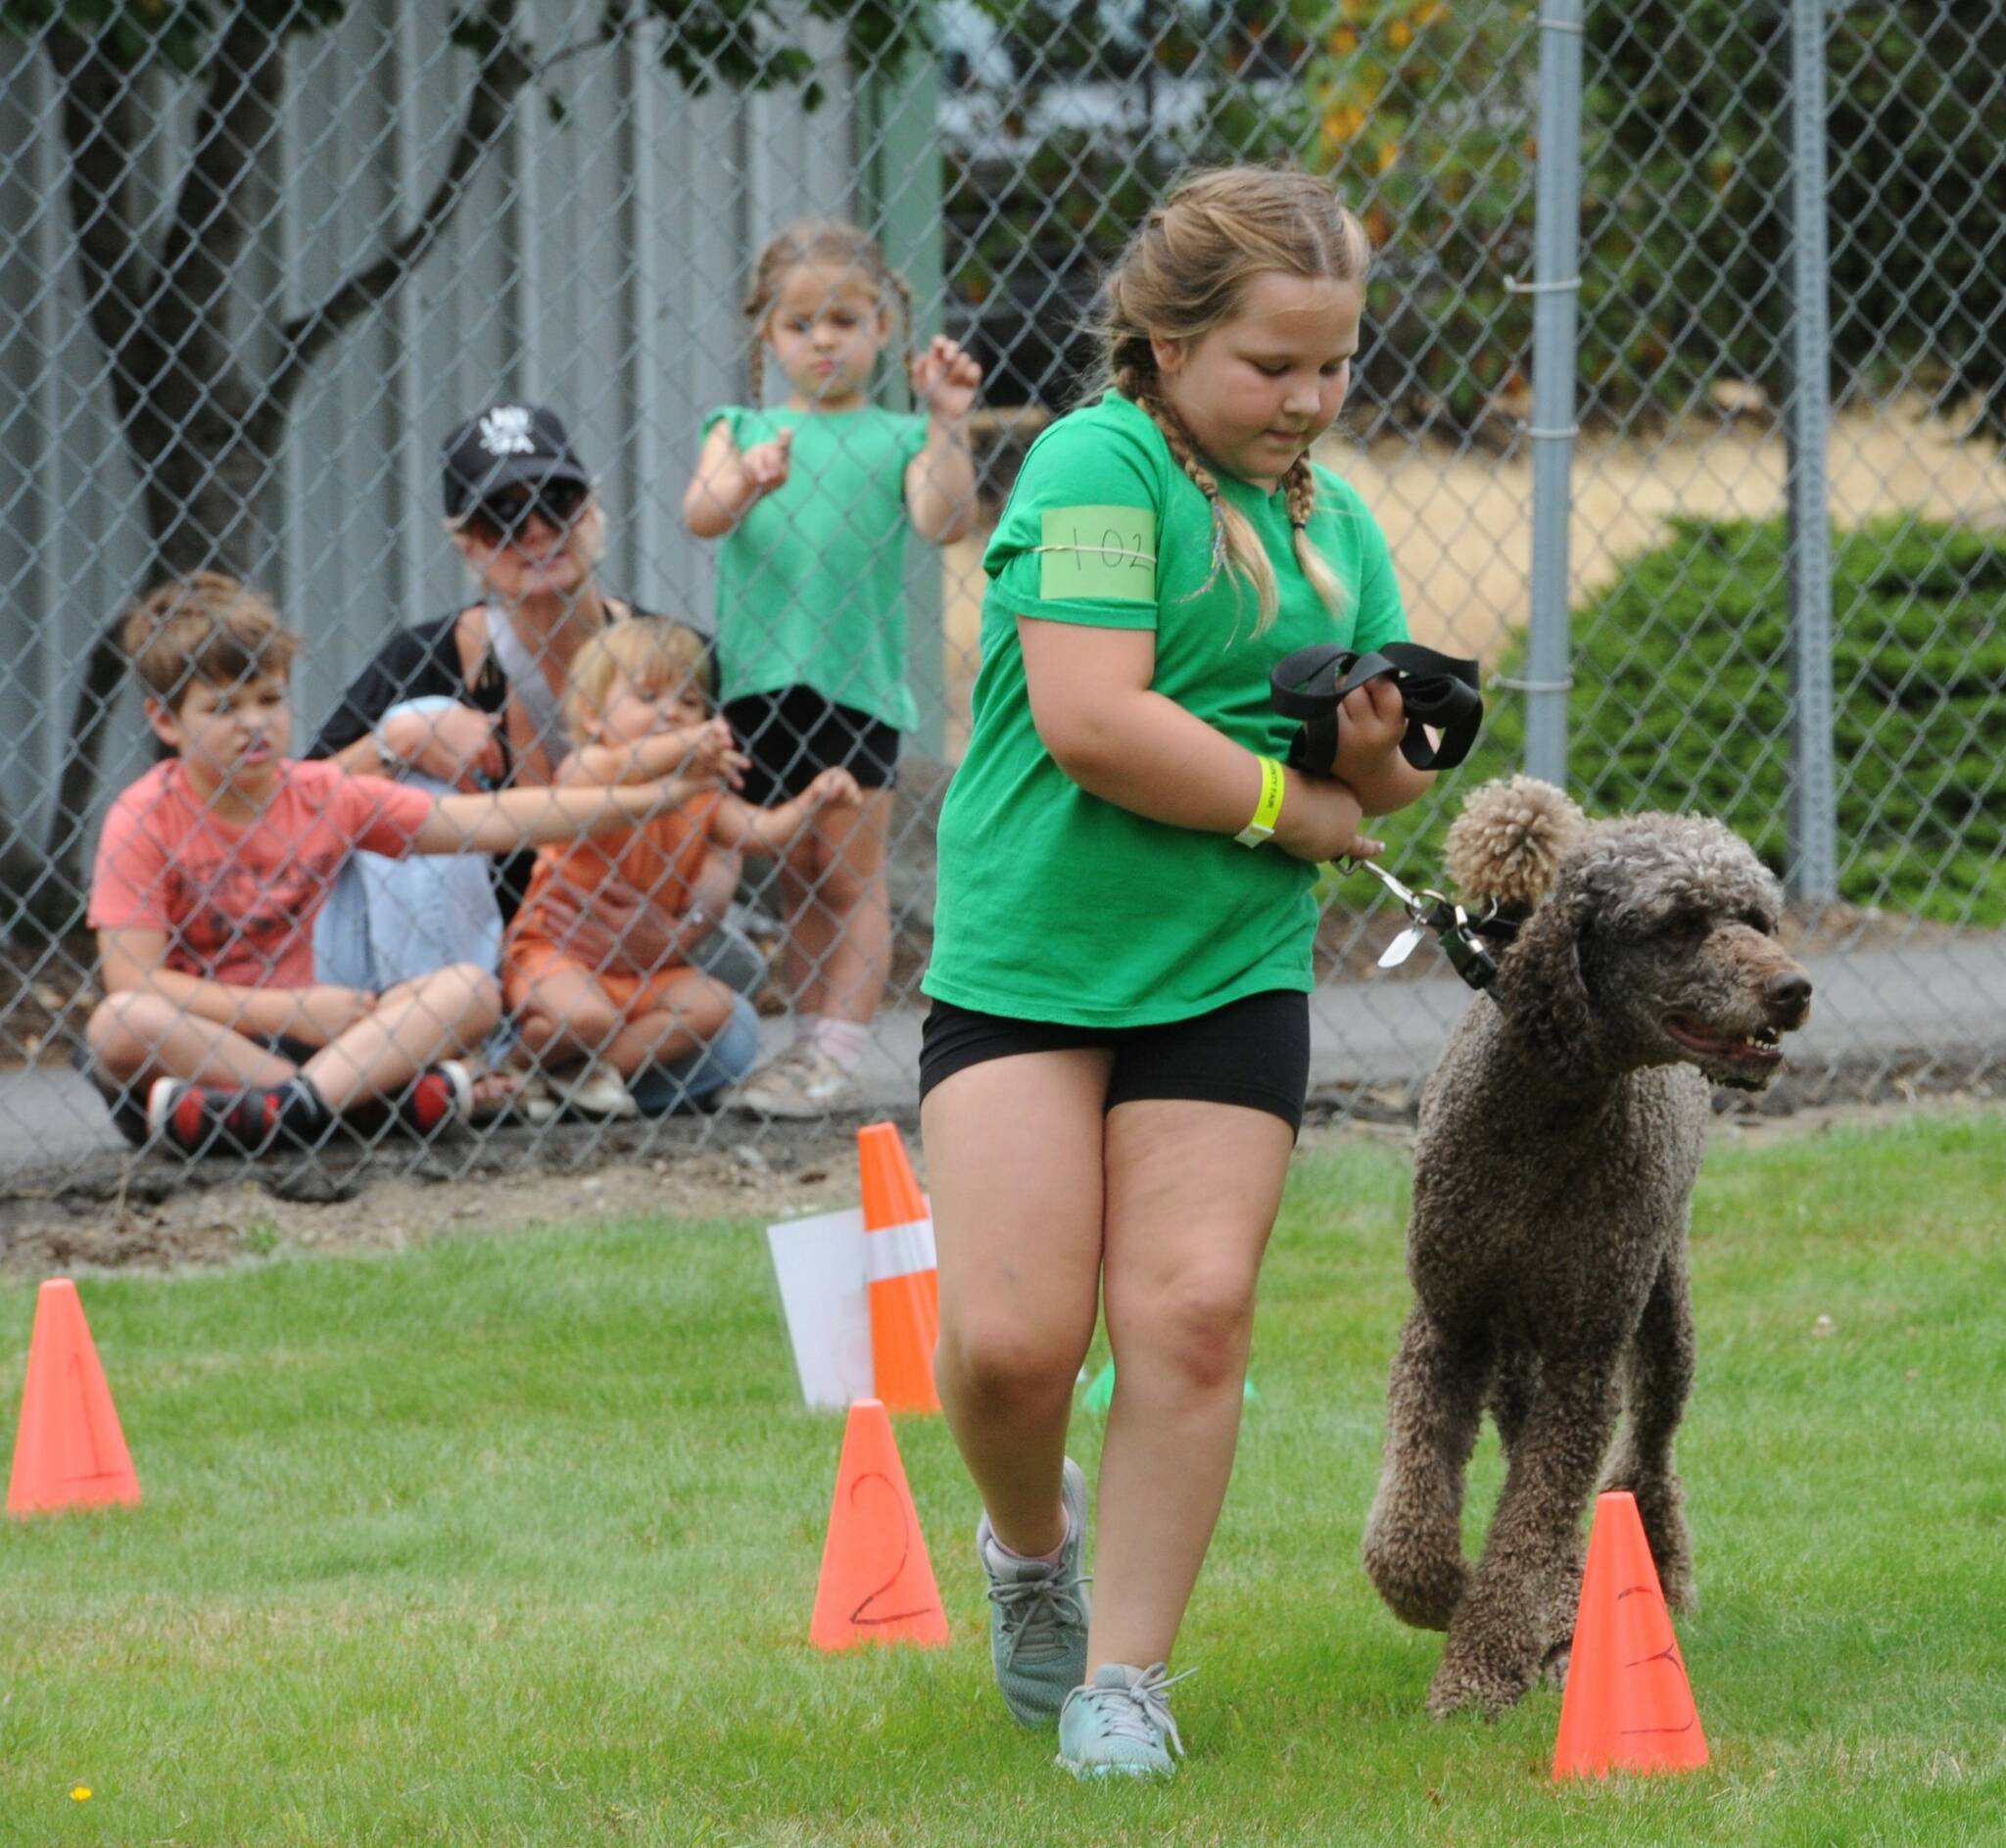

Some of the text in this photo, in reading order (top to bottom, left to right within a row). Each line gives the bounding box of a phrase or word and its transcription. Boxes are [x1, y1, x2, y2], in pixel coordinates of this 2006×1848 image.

[1074, 528, 1151, 572] 102
[63, 1352, 126, 1482] 1
[849, 1472, 935, 1626] 2
[1617, 1586, 1695, 1734] 3
